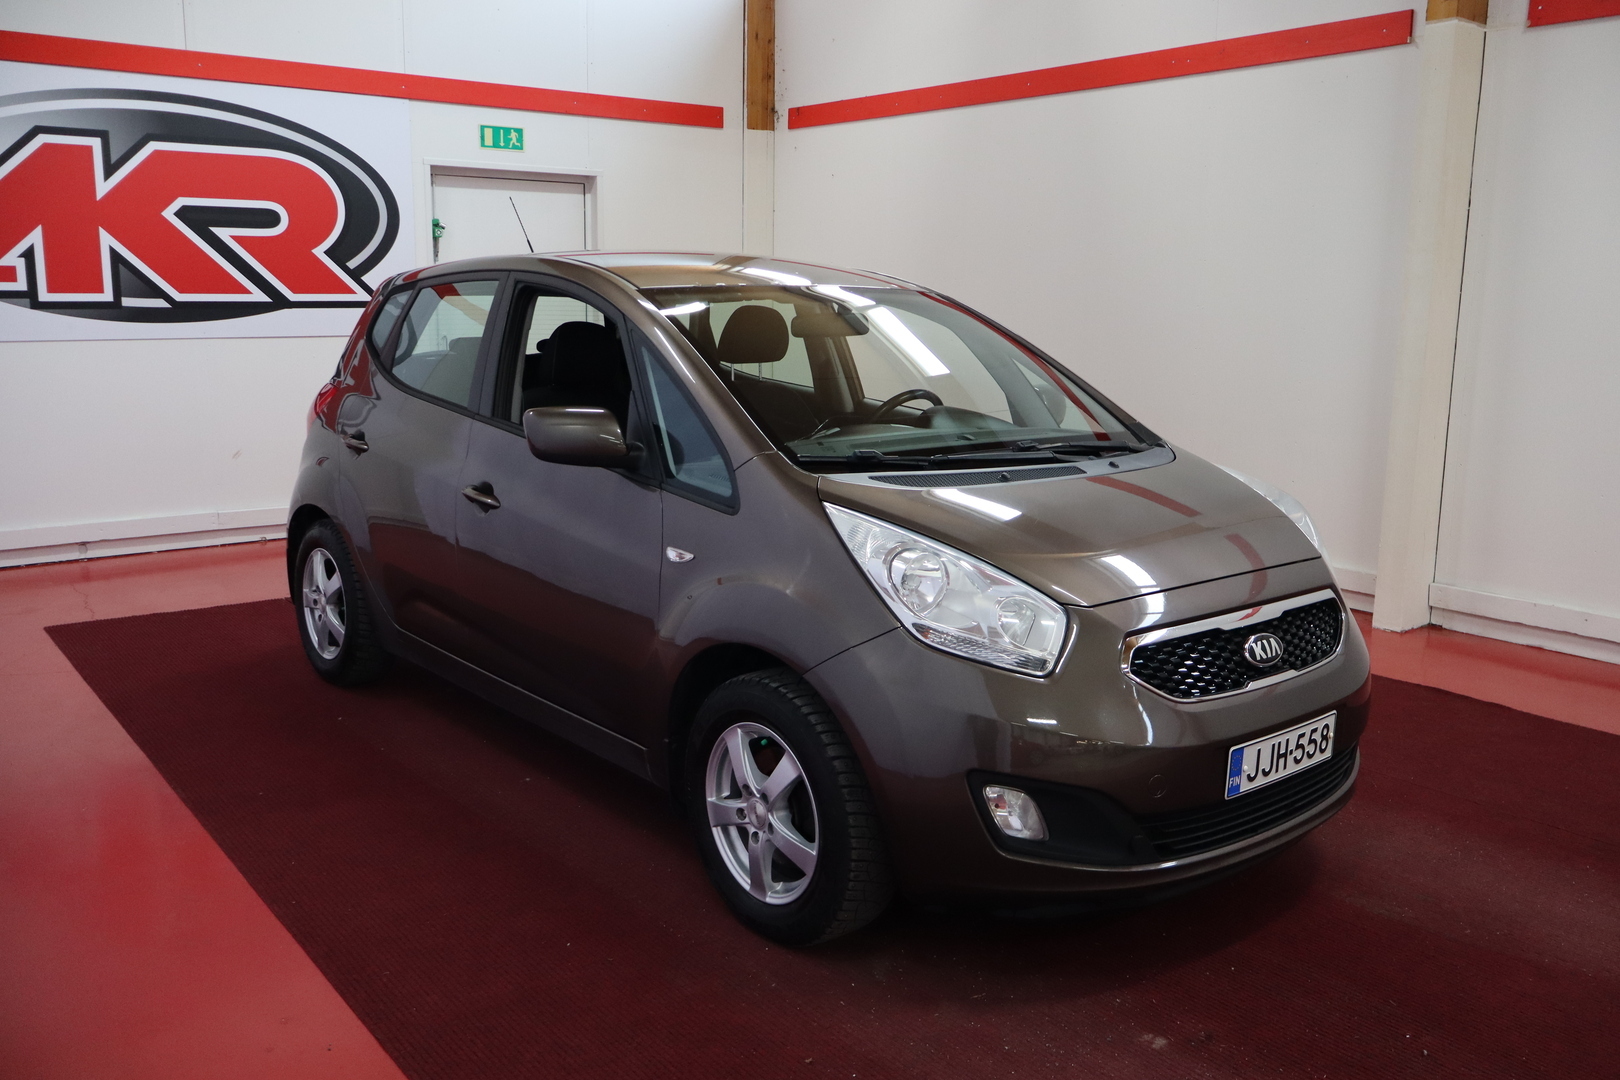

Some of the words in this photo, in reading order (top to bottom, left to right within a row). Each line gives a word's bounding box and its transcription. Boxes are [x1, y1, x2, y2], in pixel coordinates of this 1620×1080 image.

[1250, 638, 1280, 660] KIA
[1246, 723, 1330, 782] JJH-558
[1229, 775, 1241, 788] FIN
